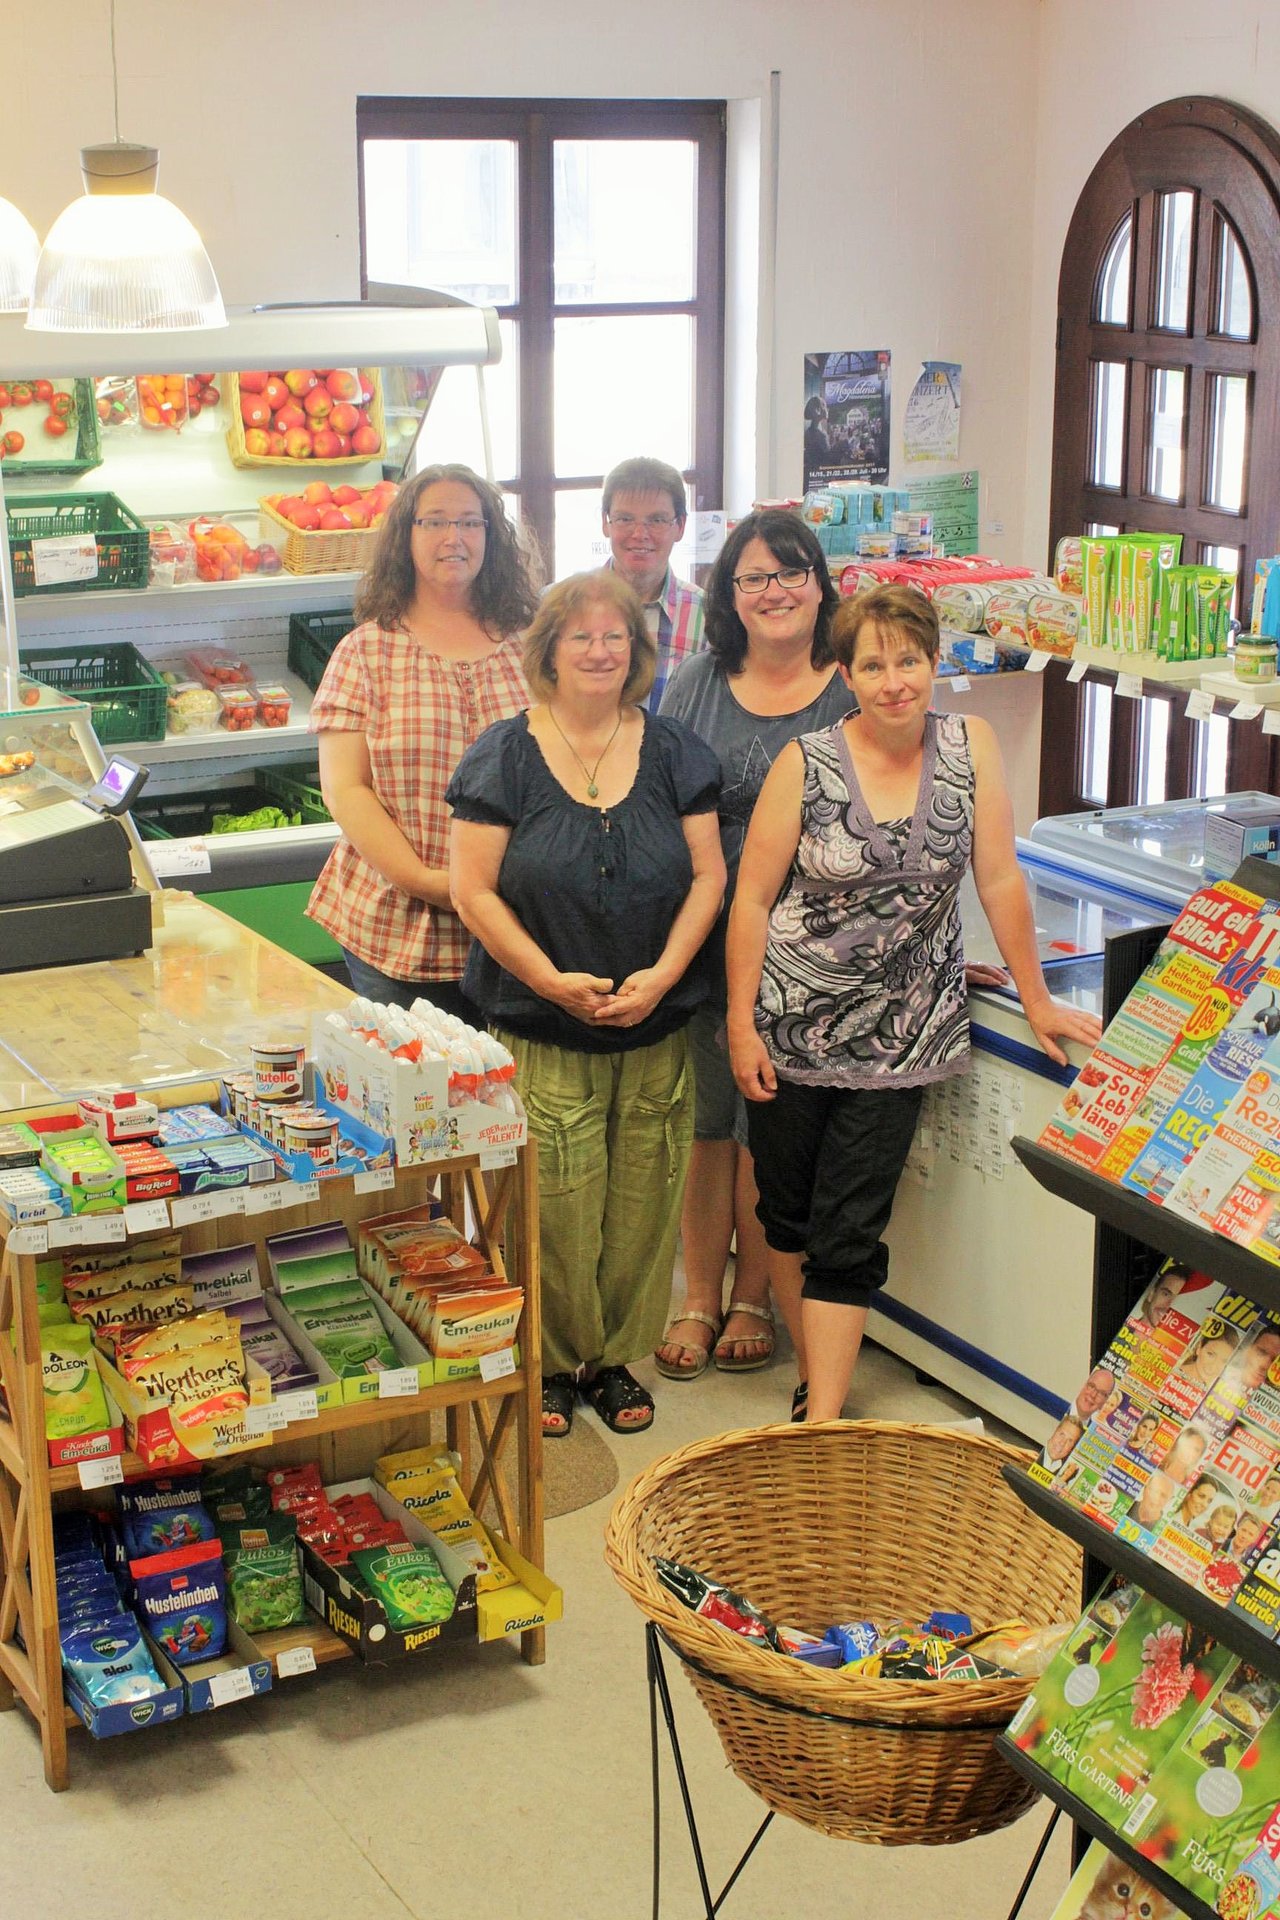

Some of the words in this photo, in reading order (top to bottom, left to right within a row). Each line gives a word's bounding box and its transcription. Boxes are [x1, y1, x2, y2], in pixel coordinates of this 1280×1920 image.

[1188, 896, 1232, 922] auf
[1173, 914, 1230, 955] Blick
[1167, 966, 1196, 987] Helfer
[1191, 965, 1214, 983] Prakt
[1161, 975, 1204, 1002] Gartenar
[1212, 998, 1228, 1013] NUR
[1223, 1031, 1265, 1057] SCHLAUE
[256, 1071, 295, 1083] nutella
[1107, 1074, 1130, 1096] So
[1095, 1089, 1126, 1116] Leb
[1183, 1083, 1215, 1115] Die
[478, 1124, 500, 1140] JEDER
[1081, 1104, 1119, 1139] läng
[1165, 1108, 1213, 1148] REC
[310, 1167, 341, 1179] nutella
[1230, 1186, 1263, 1213] PLUS
[19, 1207, 47, 1220] Orbit
[104, 1222, 118, 1231] 1.49
[193, 1269, 252, 1293] m-eukal
[304, 1309, 374, 1330] Em-eukal
[443, 1314, 515, 1337] Em-eukal
[241, 1332, 278, 1346] eukal
[1118, 1326, 1139, 1346] Das
[43, 1358, 88, 1376] POLEON
[136, 1359, 240, 1397] Werther's
[448, 1360, 480, 1377] Em-e
[213, 1422, 246, 1438] Werth
[403, 1488, 452, 1509] Ricola
[1164, 1529, 1211, 1565] TERROR-ANG
[385, 1553, 431, 1569] Eukos
[145, 1583, 219, 1616] Hustelinchen
[1235, 1591, 1276, 1626] würde
[328, 1599, 361, 1640] RIESEN
[504, 1614, 545, 1633] Ricola
[404, 1625, 441, 1651] RIESEN
[102, 1663, 133, 1678] Blau
[133, 1708, 152, 1719] WICK
[1045, 1728, 1079, 1765] FÜRS
[1077, 1755, 1137, 1813] GARTENF
[1182, 1838, 1227, 1883] FÜRS
